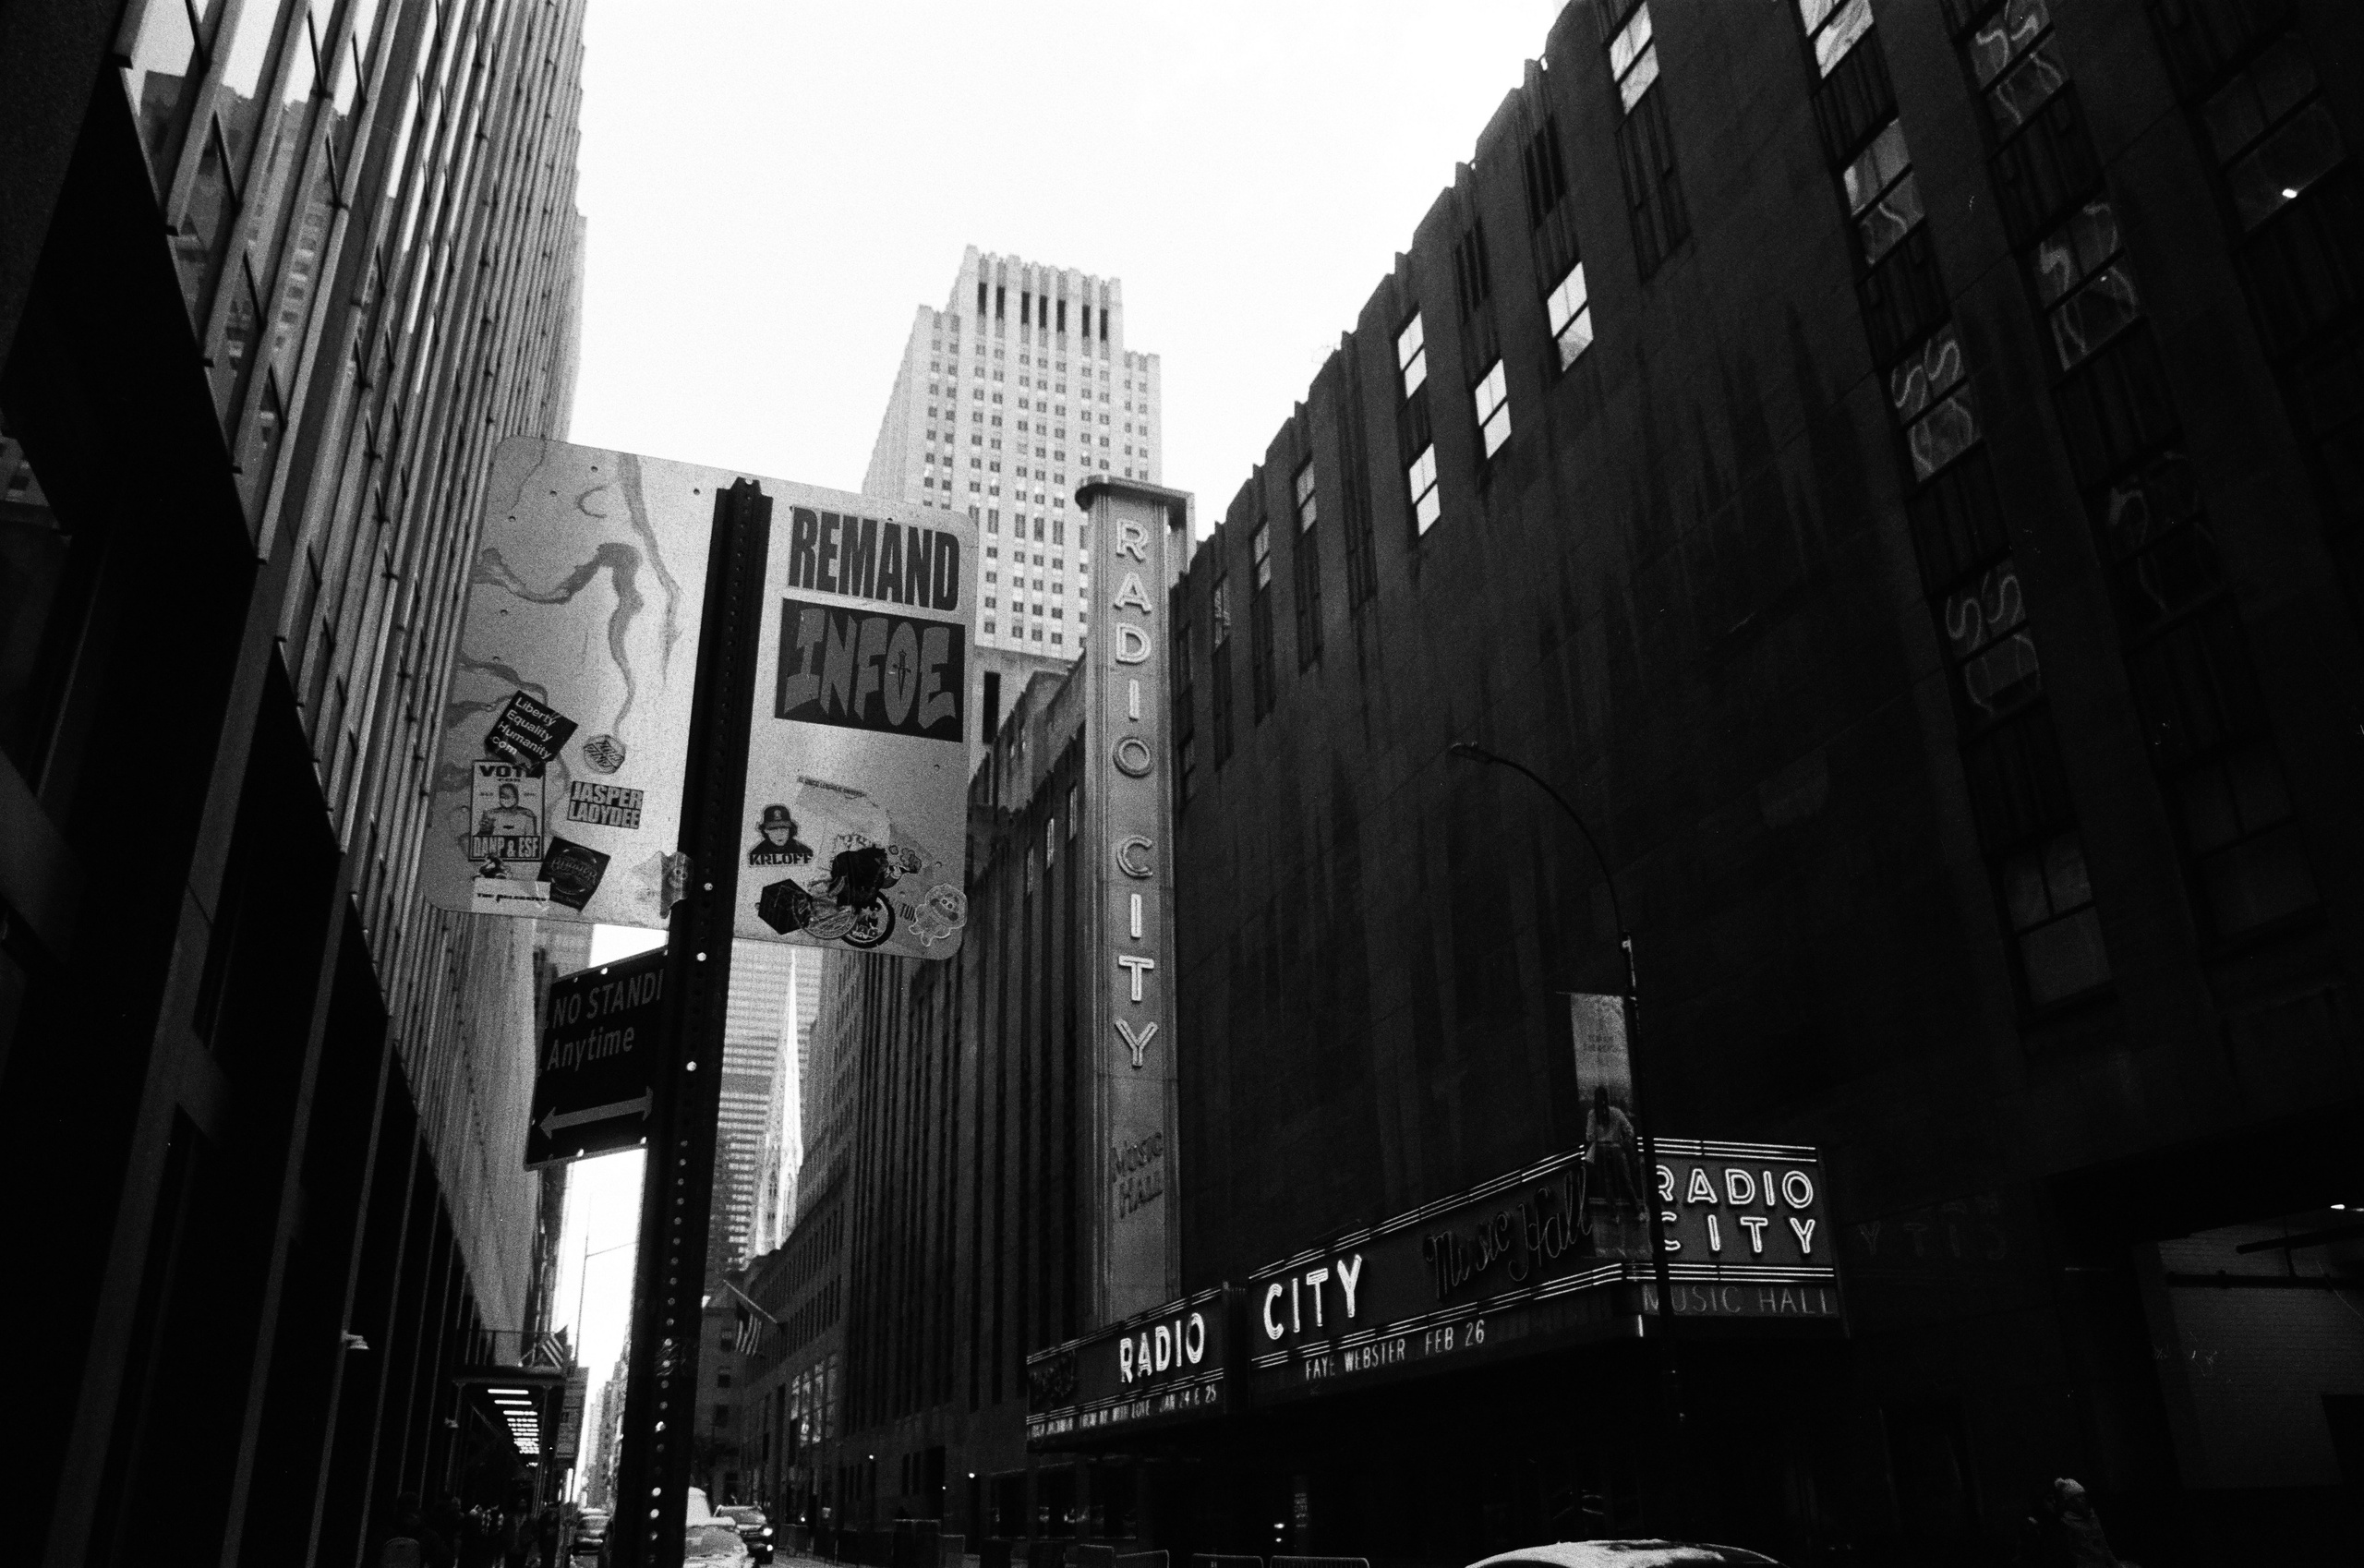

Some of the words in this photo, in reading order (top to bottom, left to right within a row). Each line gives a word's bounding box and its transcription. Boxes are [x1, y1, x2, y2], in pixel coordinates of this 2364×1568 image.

[788, 506, 959, 611] REMAND
[784, 607, 956, 730] INFOE
[1113, 517, 1154, 778] RADIO
[507, 709, 553, 742] Equality
[515, 696, 557, 727] Liberty
[498, 721, 552, 760] Humanity
[479, 765, 524, 778] VOT
[569, 802, 641, 829] LADYDEE
[571, 782, 644, 810] JASPER
[1115, 835, 1159, 1068] CITY
[552, 992, 583, 1030] NO
[585, 969, 665, 1019] STANDI
[546, 1025, 635, 1072] Anytime
[1655, 1164, 1815, 1210] RADIO
[1422, 1212, 1512, 1301] Music
[1507, 1165, 1594, 1284] Hall
[1660, 1211, 1816, 1255] CITY
[1262, 1253, 1364, 1341] CITY
[1642, 1285, 1742, 1314] MUSIC
[1758, 1286, 1834, 1315] HALL
[1118, 1310, 1206, 1384] RADIO
[1304, 1356, 1336, 1381] FAYE
[1344, 1338, 1406, 1374] WEBSTER
[1424, 1325, 1454, 1357] FEB
[1465, 1319, 1486, 1348] 26
[1204, 1382, 1218, 1405] 25
